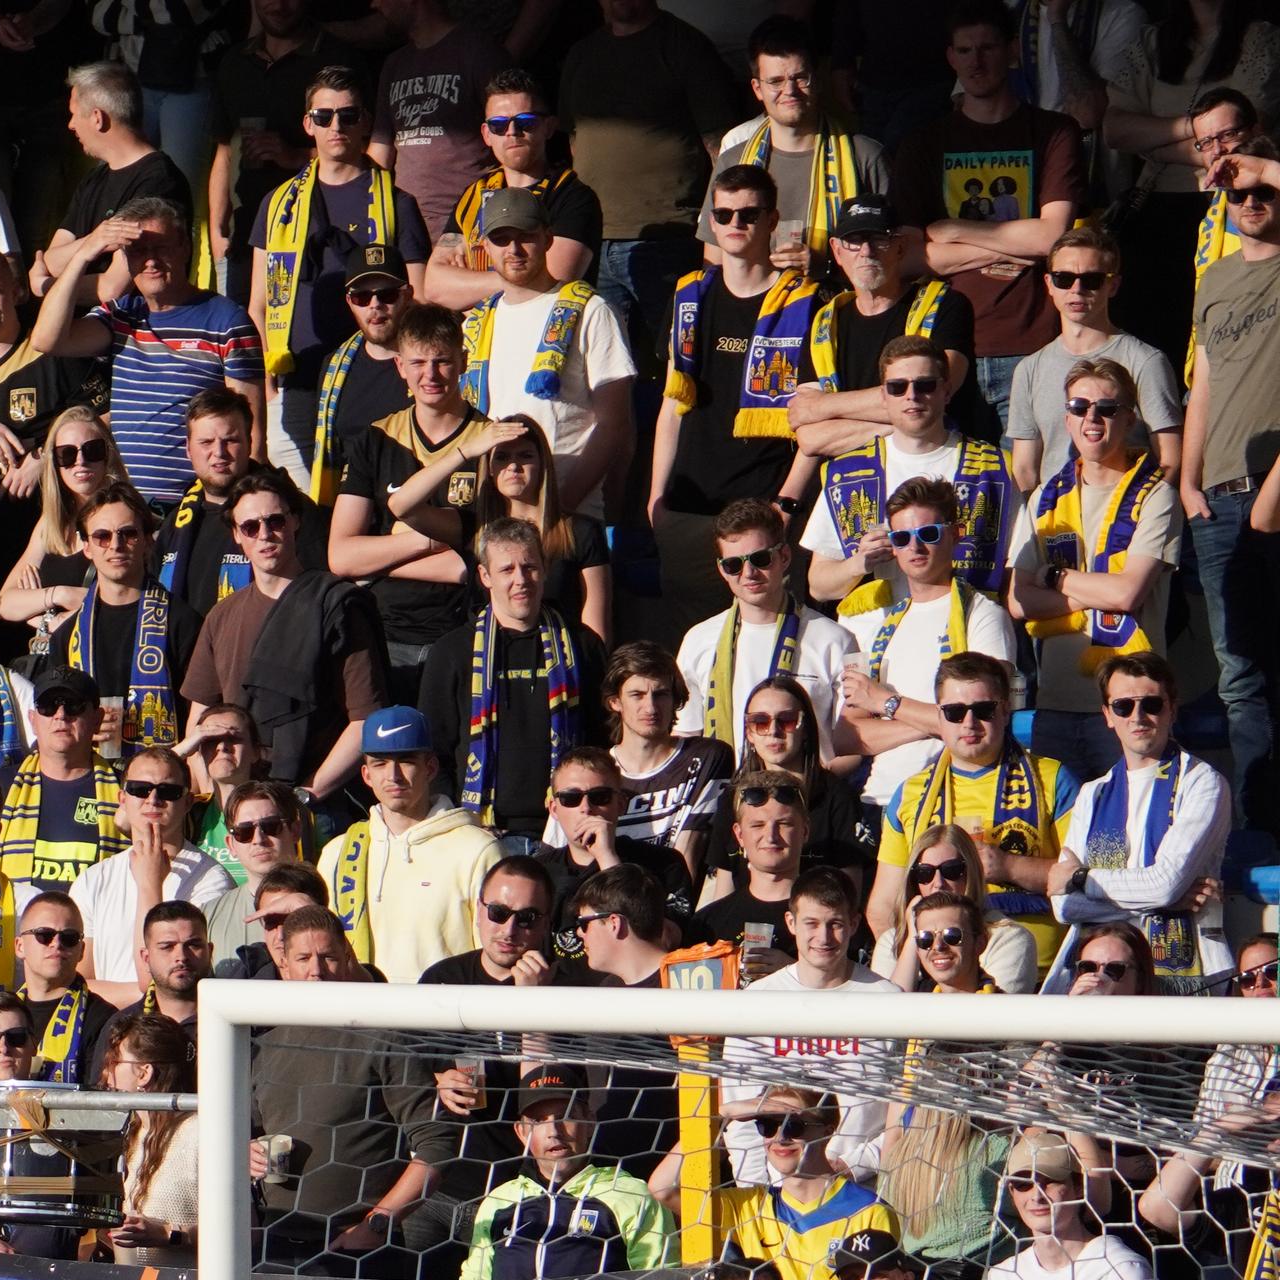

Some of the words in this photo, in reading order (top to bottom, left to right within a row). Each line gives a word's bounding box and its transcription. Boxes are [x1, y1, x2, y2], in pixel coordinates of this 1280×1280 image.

[944, 158, 986, 170] DAILY
[989, 156, 1030, 168] PAPER
[716, 337, 749, 353] 2024
[529, 1076, 562, 1090] STIHL
[850, 1233, 871, 1252] NY
